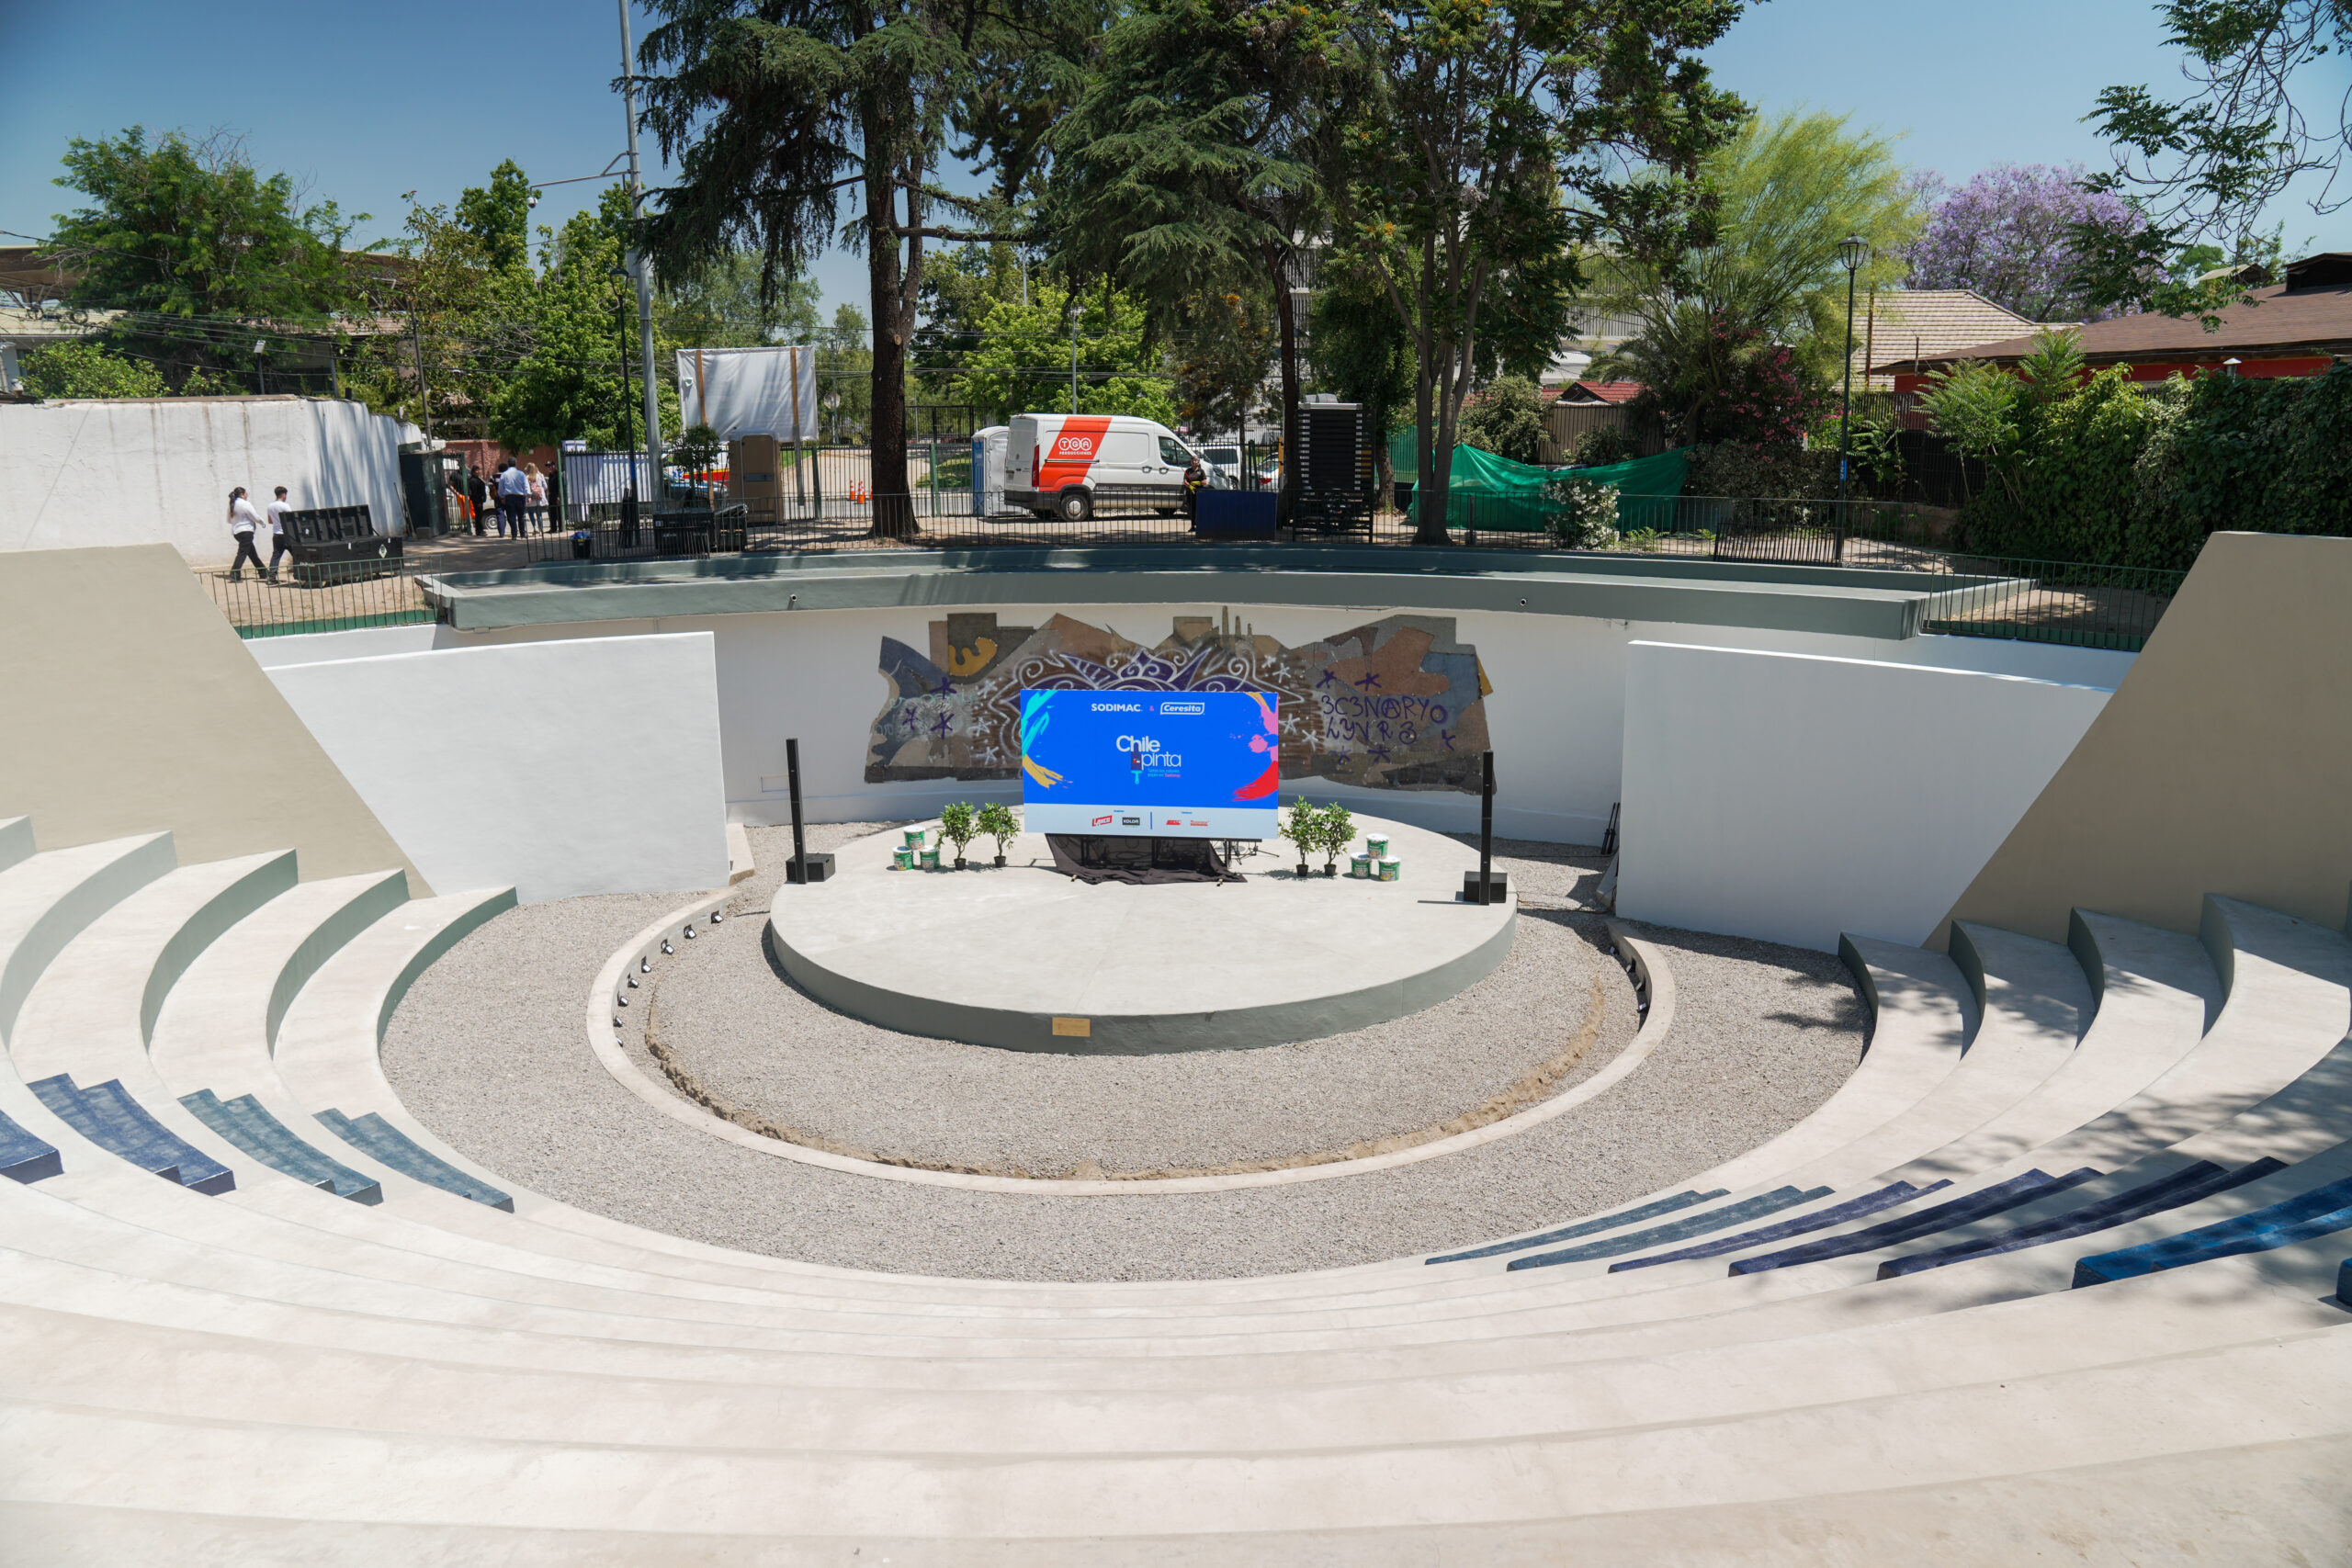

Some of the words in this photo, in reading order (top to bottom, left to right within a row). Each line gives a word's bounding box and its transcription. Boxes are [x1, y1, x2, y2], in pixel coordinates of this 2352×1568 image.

[1060, 439, 1091, 449] TGA
[1091, 703, 1142, 713] SODIMAC
[1163, 705, 1202, 713] Ceresita
[1115, 735, 1160, 752] Chile
[1141, 750, 1182, 771] pinta
